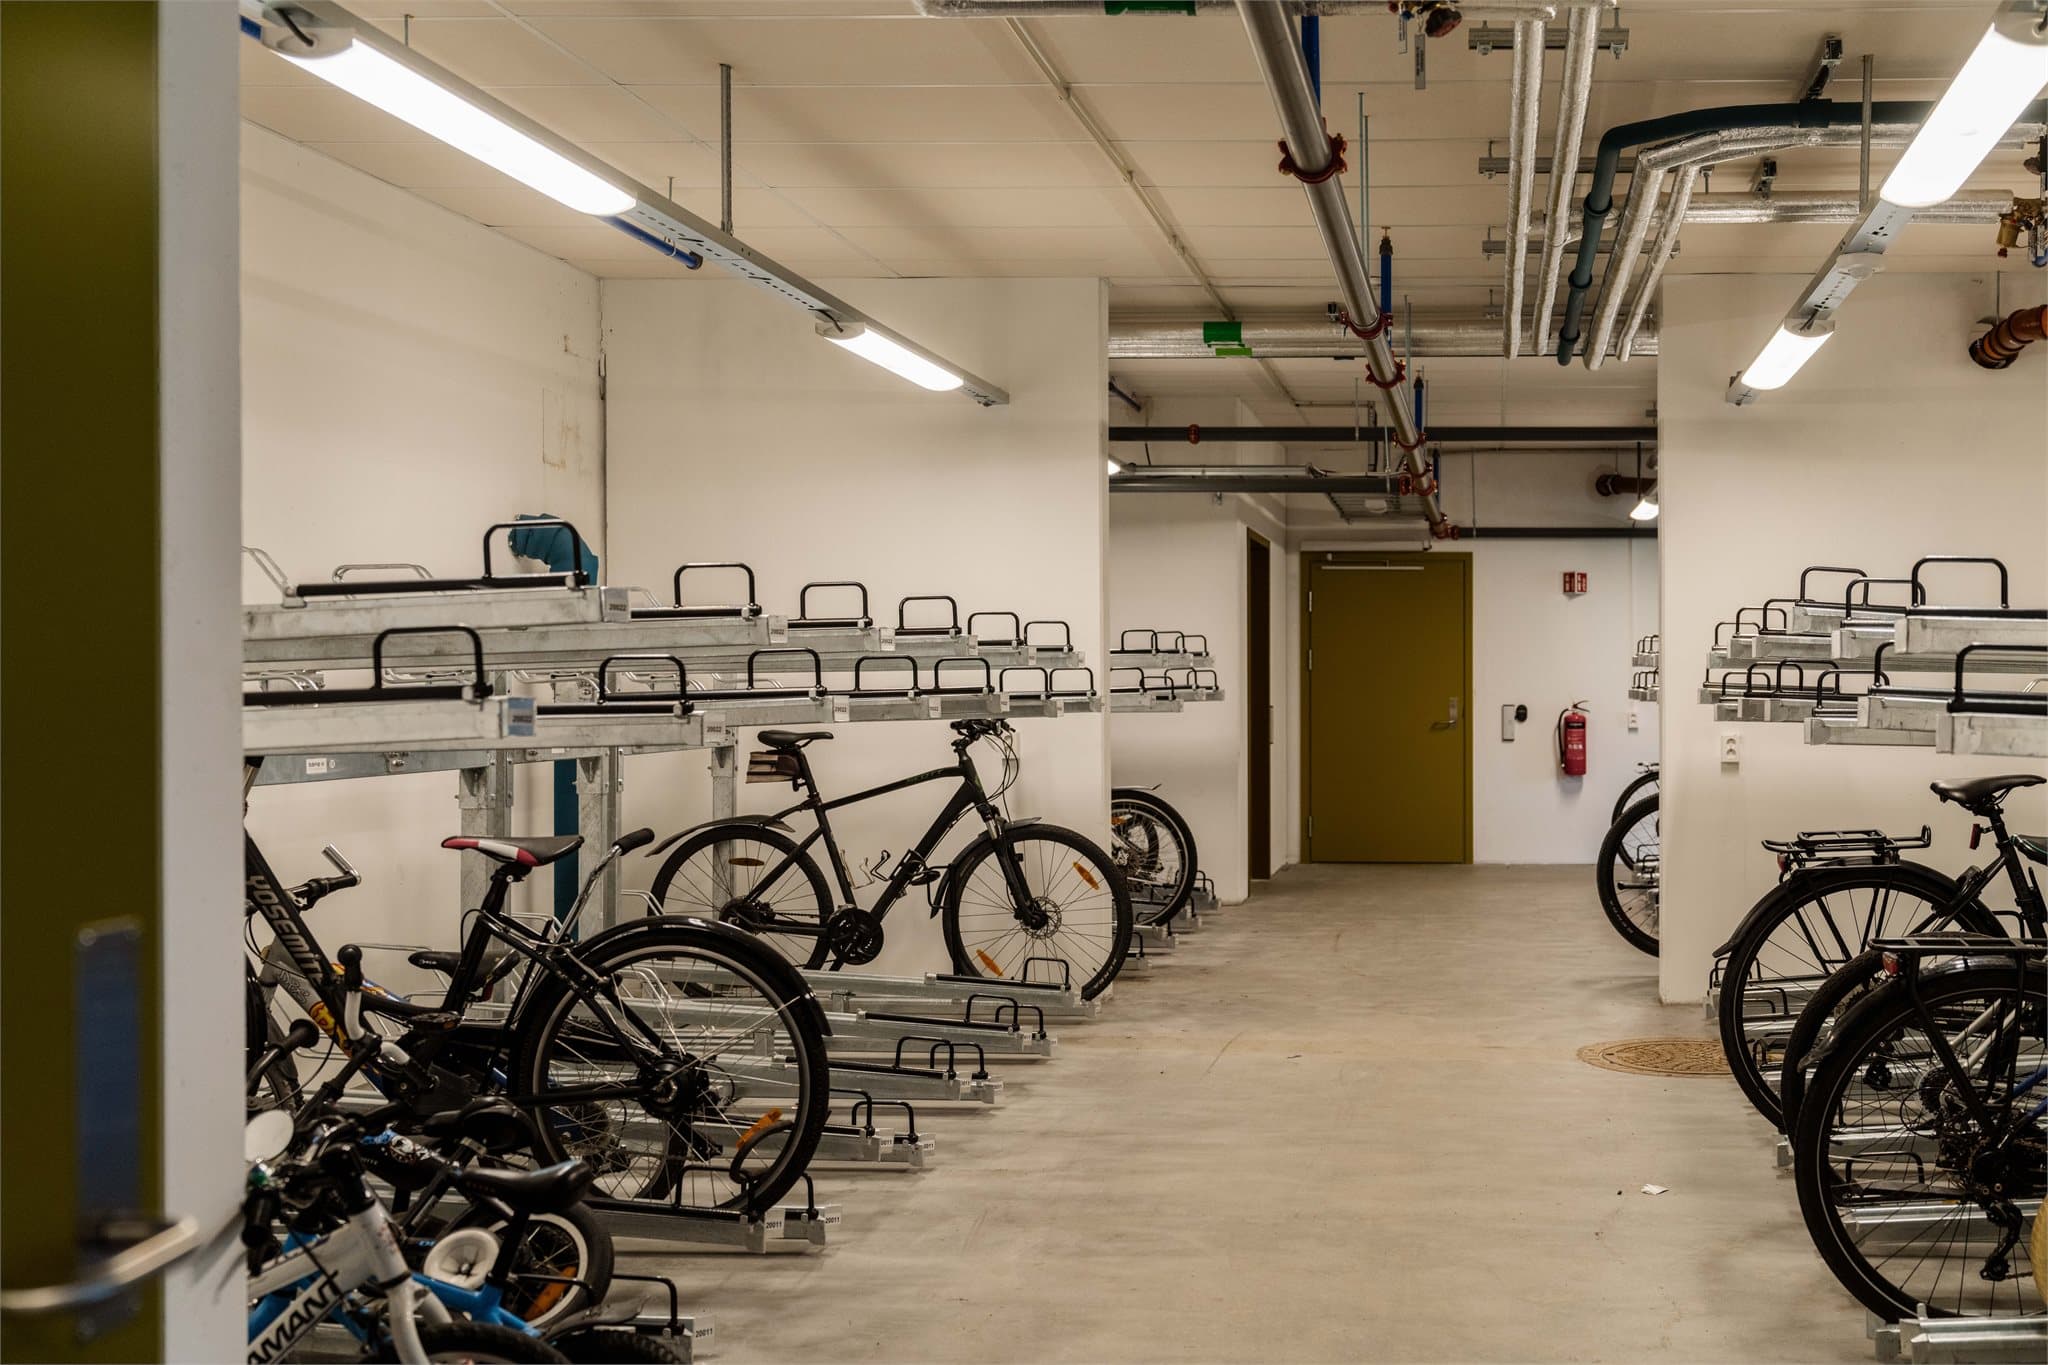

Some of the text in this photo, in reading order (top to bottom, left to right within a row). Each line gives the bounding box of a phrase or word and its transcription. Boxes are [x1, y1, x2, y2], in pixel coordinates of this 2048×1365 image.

[825, 1216, 840, 1224] 20011
[766, 1221, 782, 1230] 20011
[695, 1328, 713, 1338] 20011
